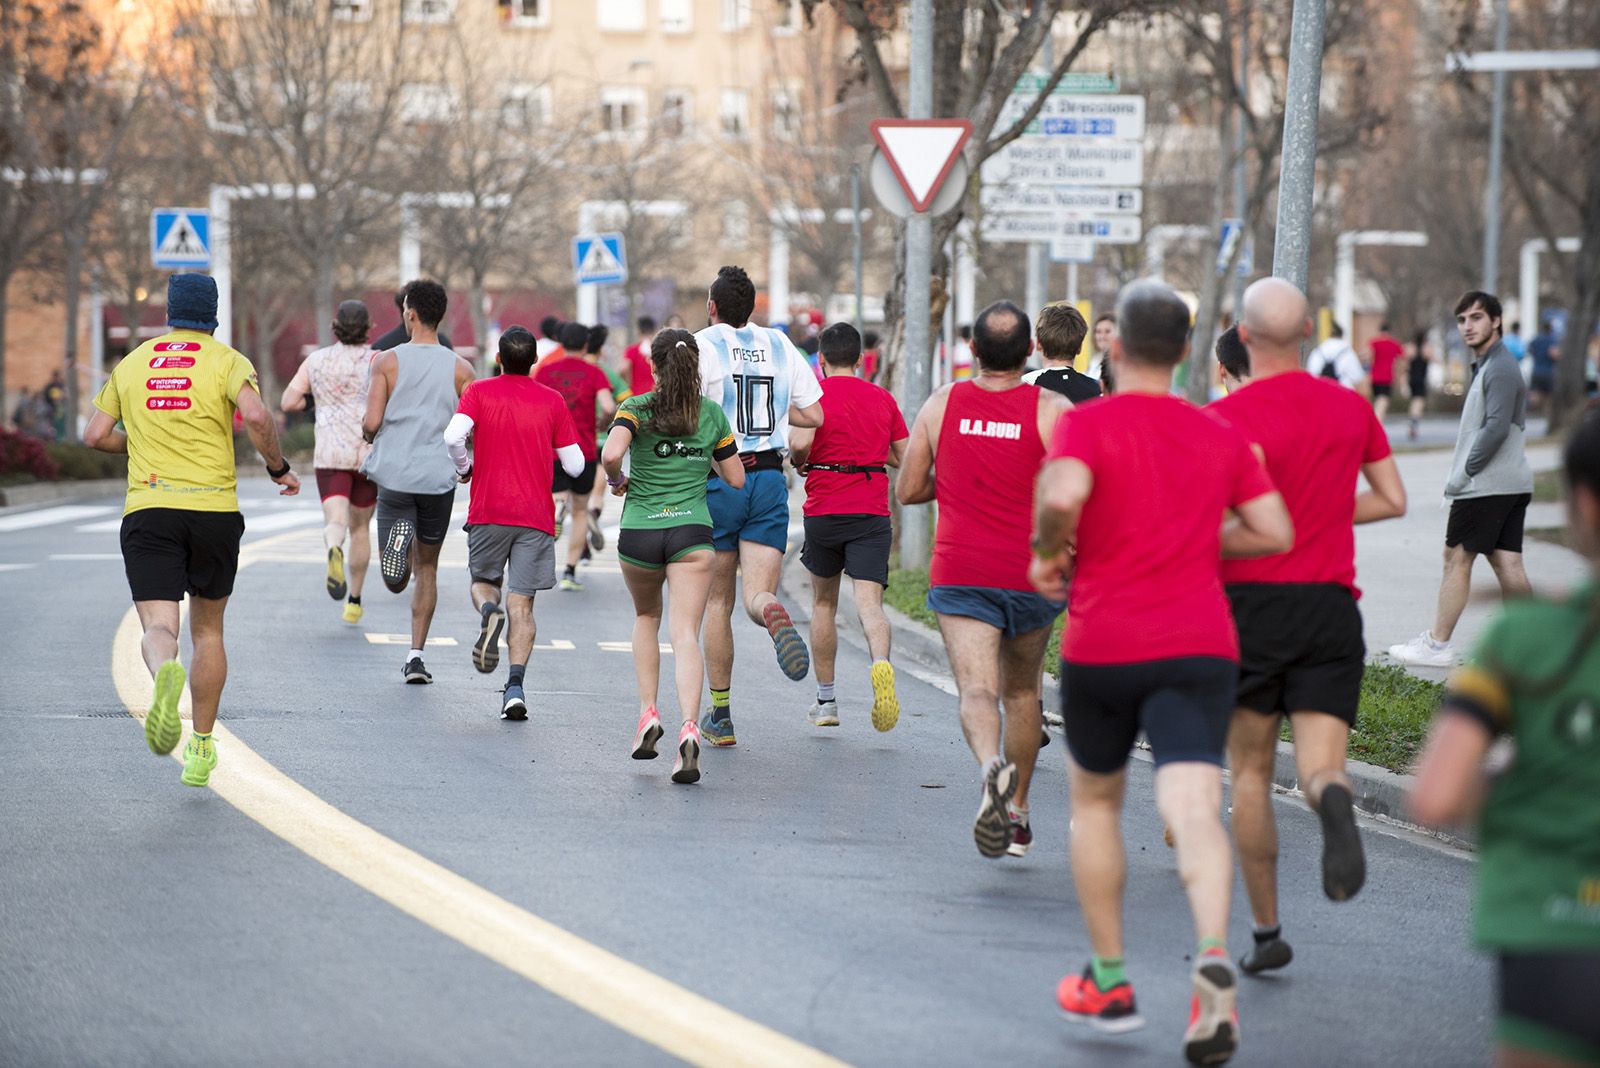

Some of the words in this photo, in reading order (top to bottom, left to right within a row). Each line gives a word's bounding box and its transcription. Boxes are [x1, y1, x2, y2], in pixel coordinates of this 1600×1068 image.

[732, 347, 767, 362] MESSI
[732, 373, 775, 436] 10
[959, 418, 1022, 440] U.A.RUBI
